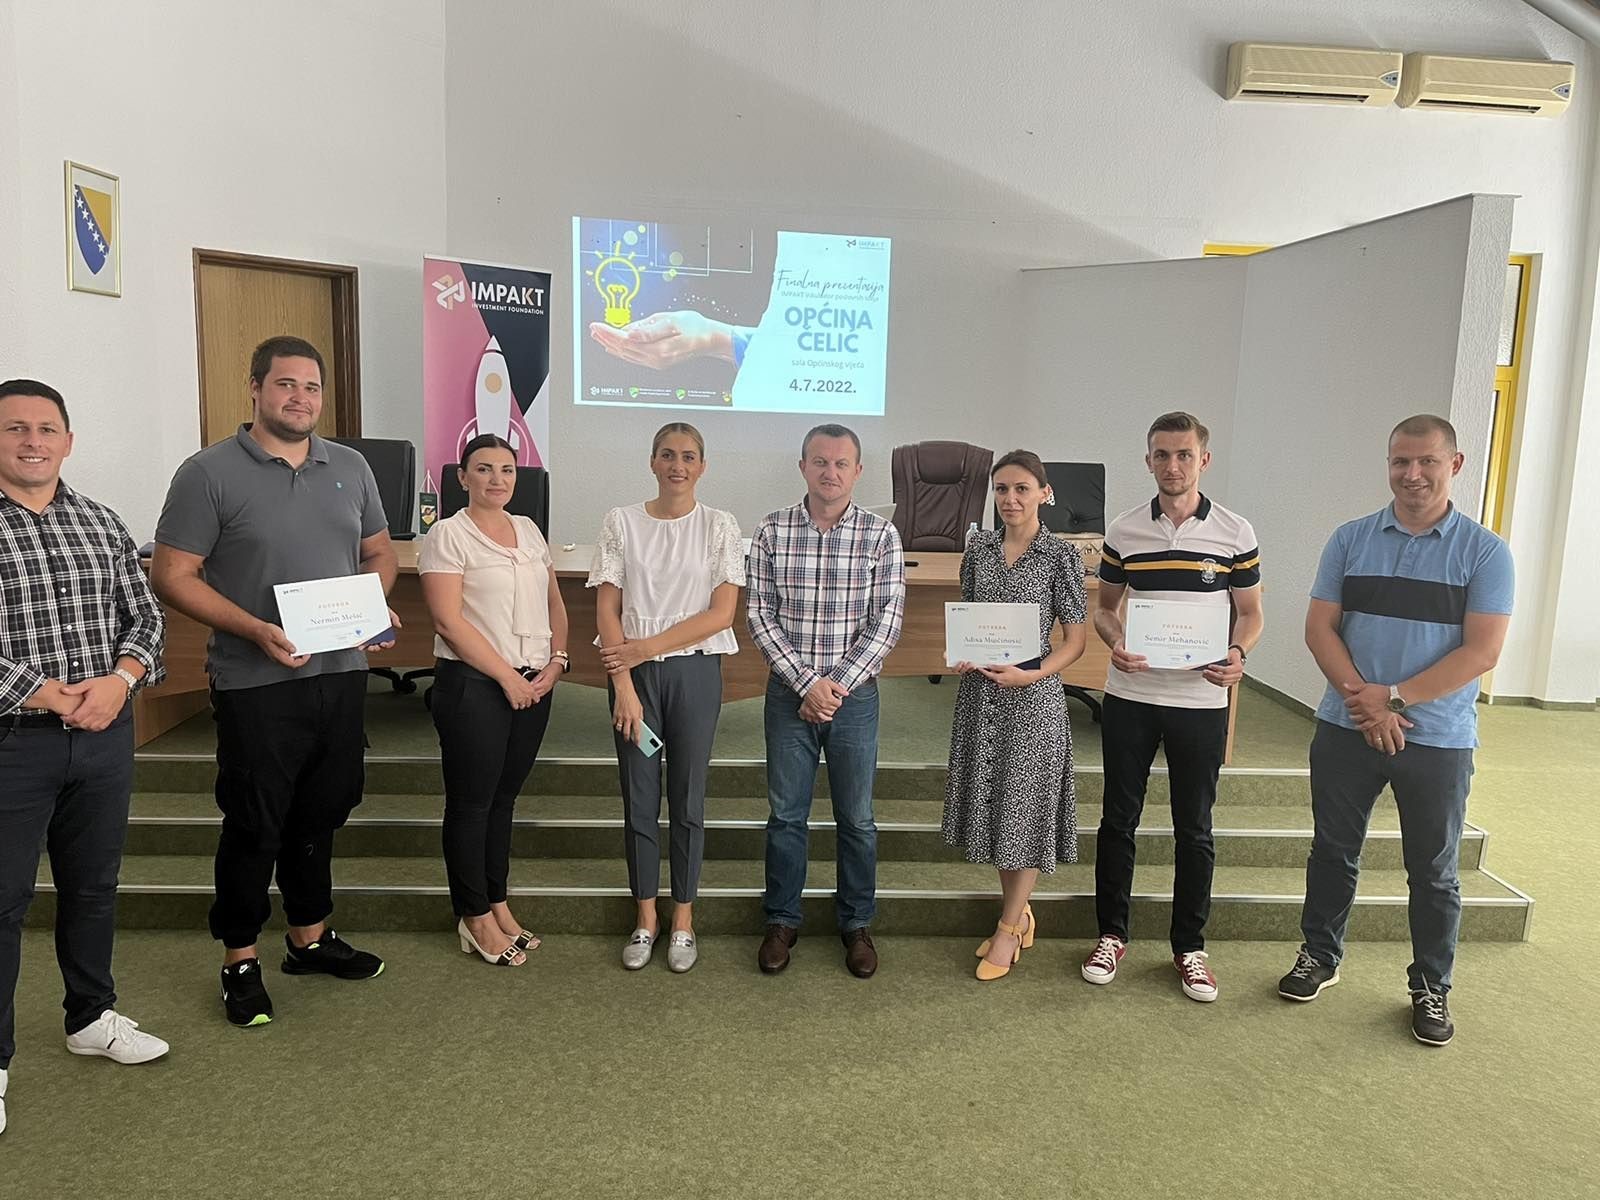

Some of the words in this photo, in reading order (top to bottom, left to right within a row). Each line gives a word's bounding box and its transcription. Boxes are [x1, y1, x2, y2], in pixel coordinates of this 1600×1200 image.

[777, 268, 820, 291] Finalna
[471, 281, 544, 306] IMPAKT
[471, 303, 507, 312] INVESTMENT
[508, 305, 544, 315] FOUNDATION
[785, 302, 873, 330] OPĆINA
[789, 378, 857, 393] 4.7.2022.
